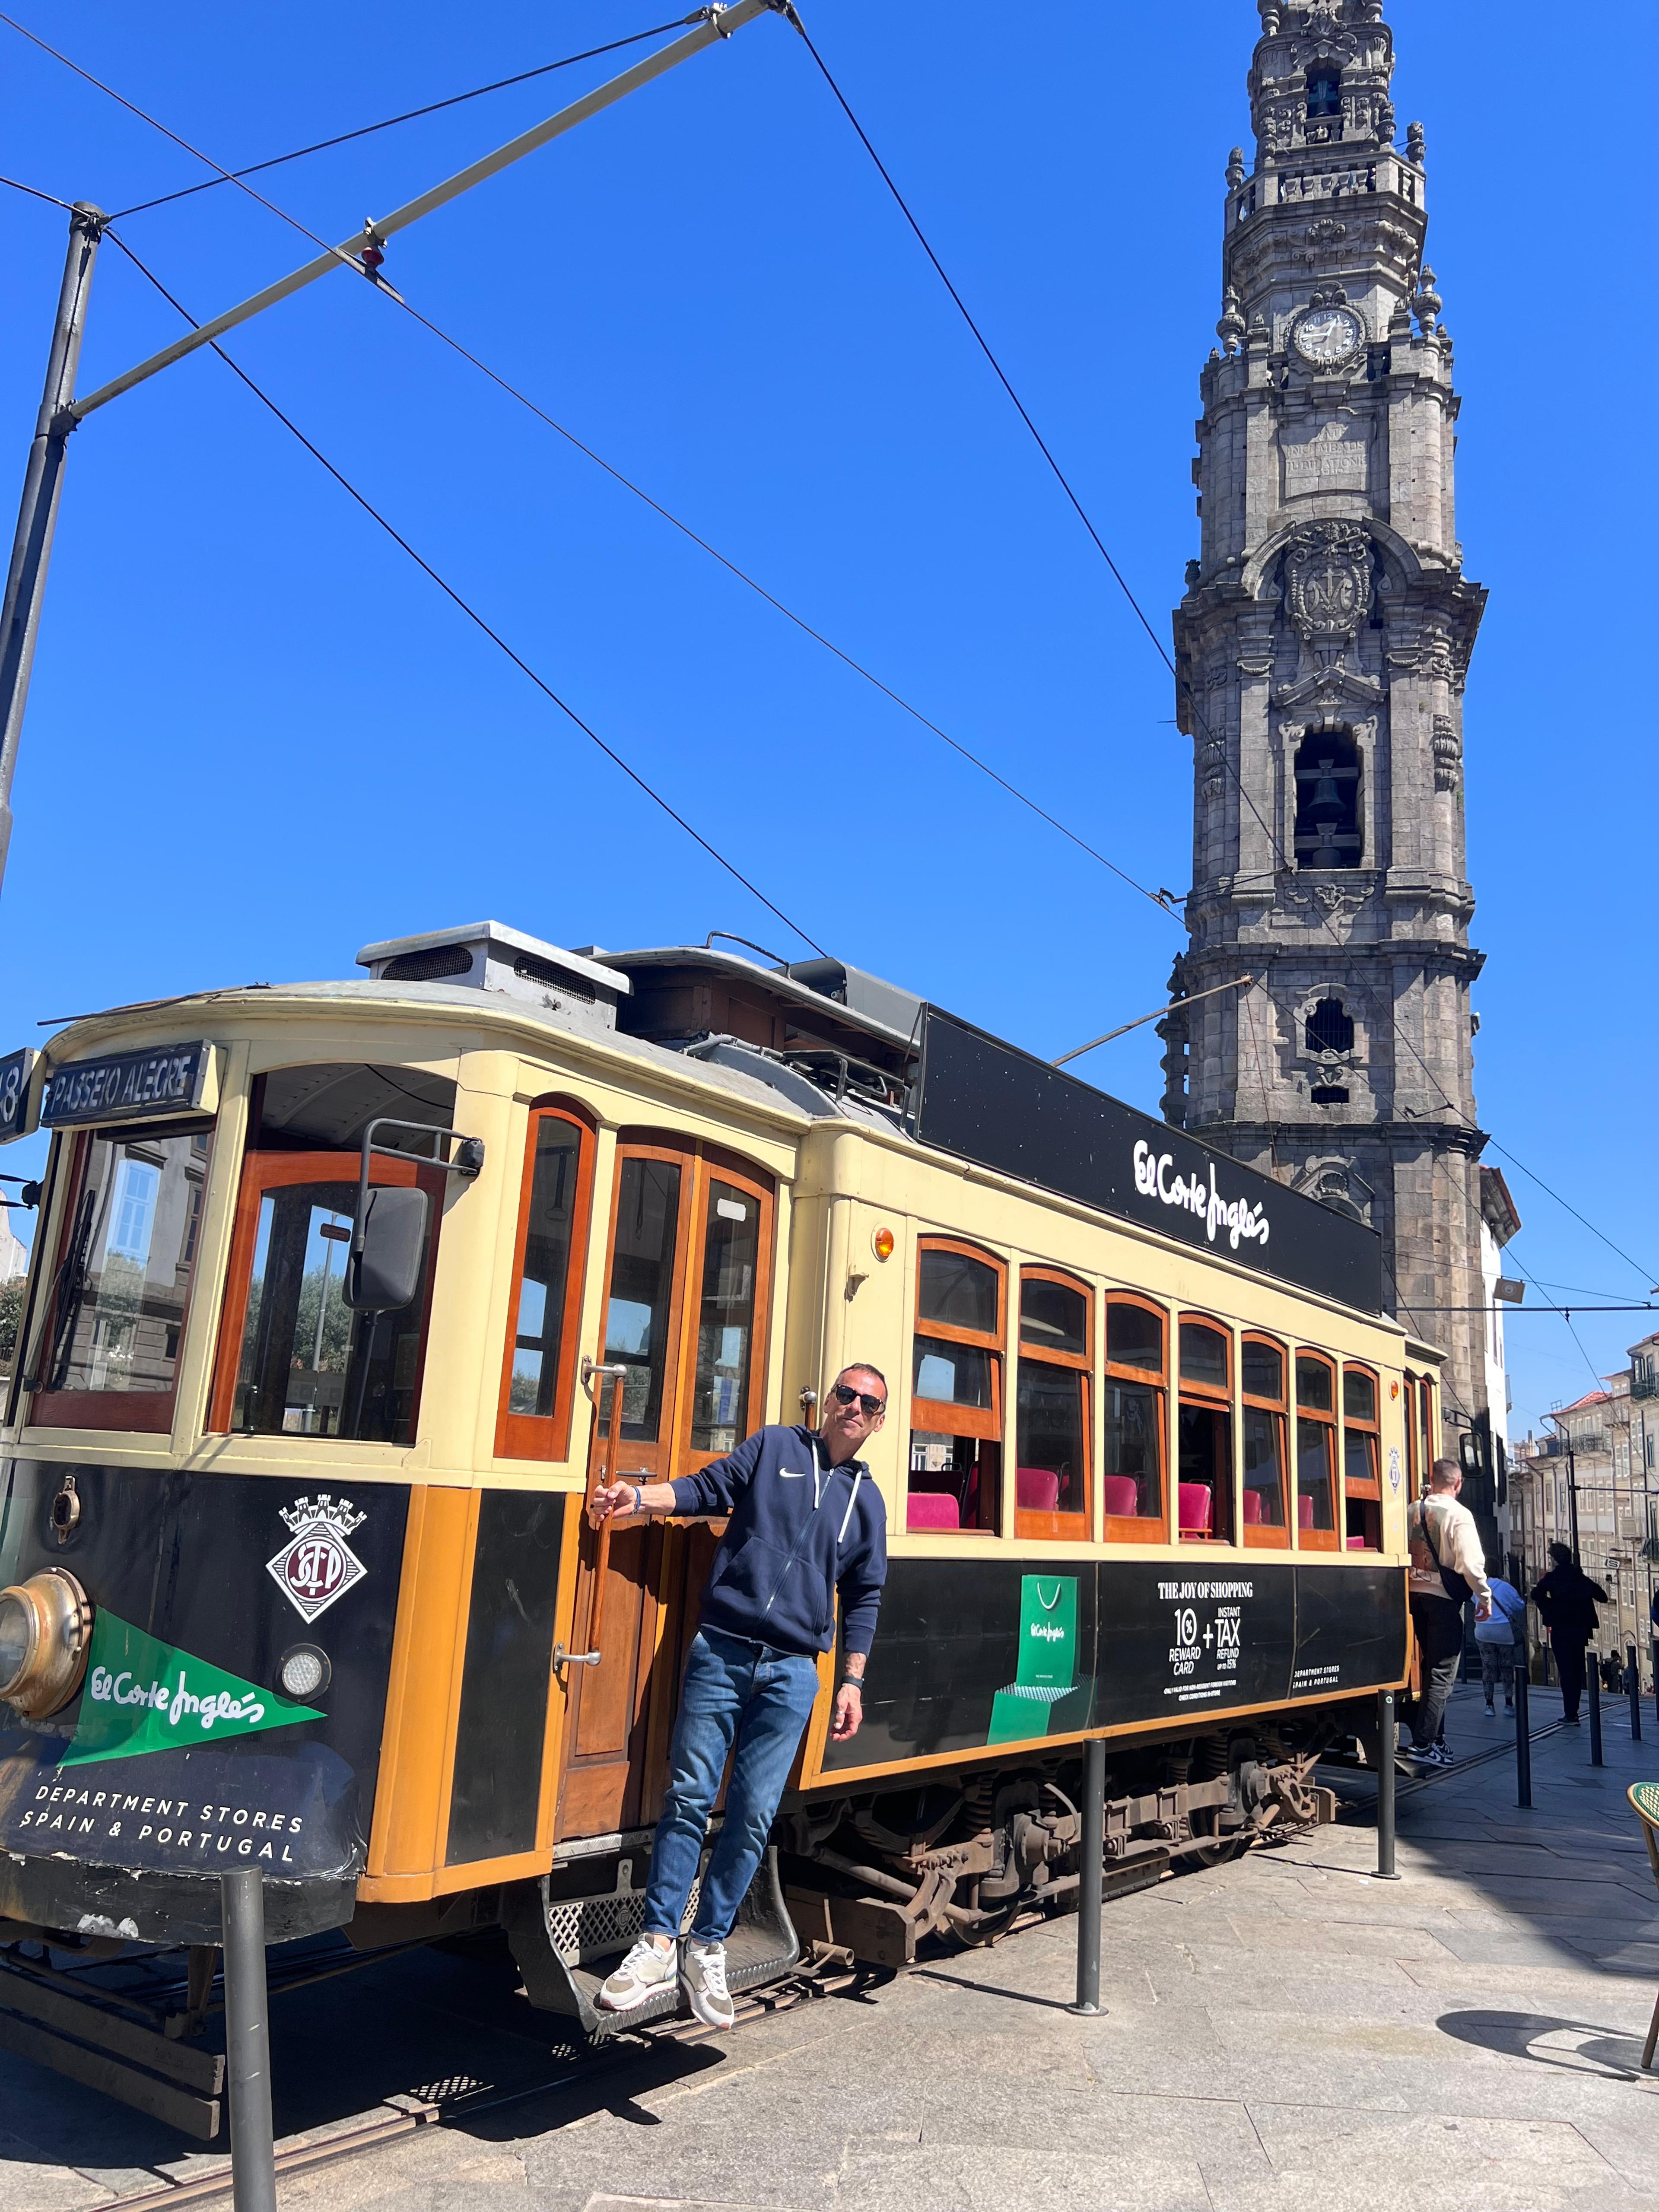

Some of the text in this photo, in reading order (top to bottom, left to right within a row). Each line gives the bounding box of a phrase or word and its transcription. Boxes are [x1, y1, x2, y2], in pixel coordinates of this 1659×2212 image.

[50, 1067, 121, 1113] PASSEIO
[1133, 1140, 1270, 1249] El Corte Inglés
[1157, 1581, 1253, 1599] THE JOY OF SHOPPING
[1217, 1606, 1241, 1618] INSTANT
[1214, 1618, 1241, 1648] TAX
[1169, 1646, 1201, 1662] REWARD
[1216, 1647, 1239, 1659] REFUND
[1173, 1661, 1195, 1676] CARD
[1294, 1665, 1339, 1678] DEPARTMENT STORES
[1313, 1675, 1339, 1686] PORTUGAL
[91, 1666, 265, 1729] El Corte Inglés
[35, 1786, 303, 1834] DEPARTMENT STORES
[19, 1810, 294, 1862] SPAIN & PORTUGAL
